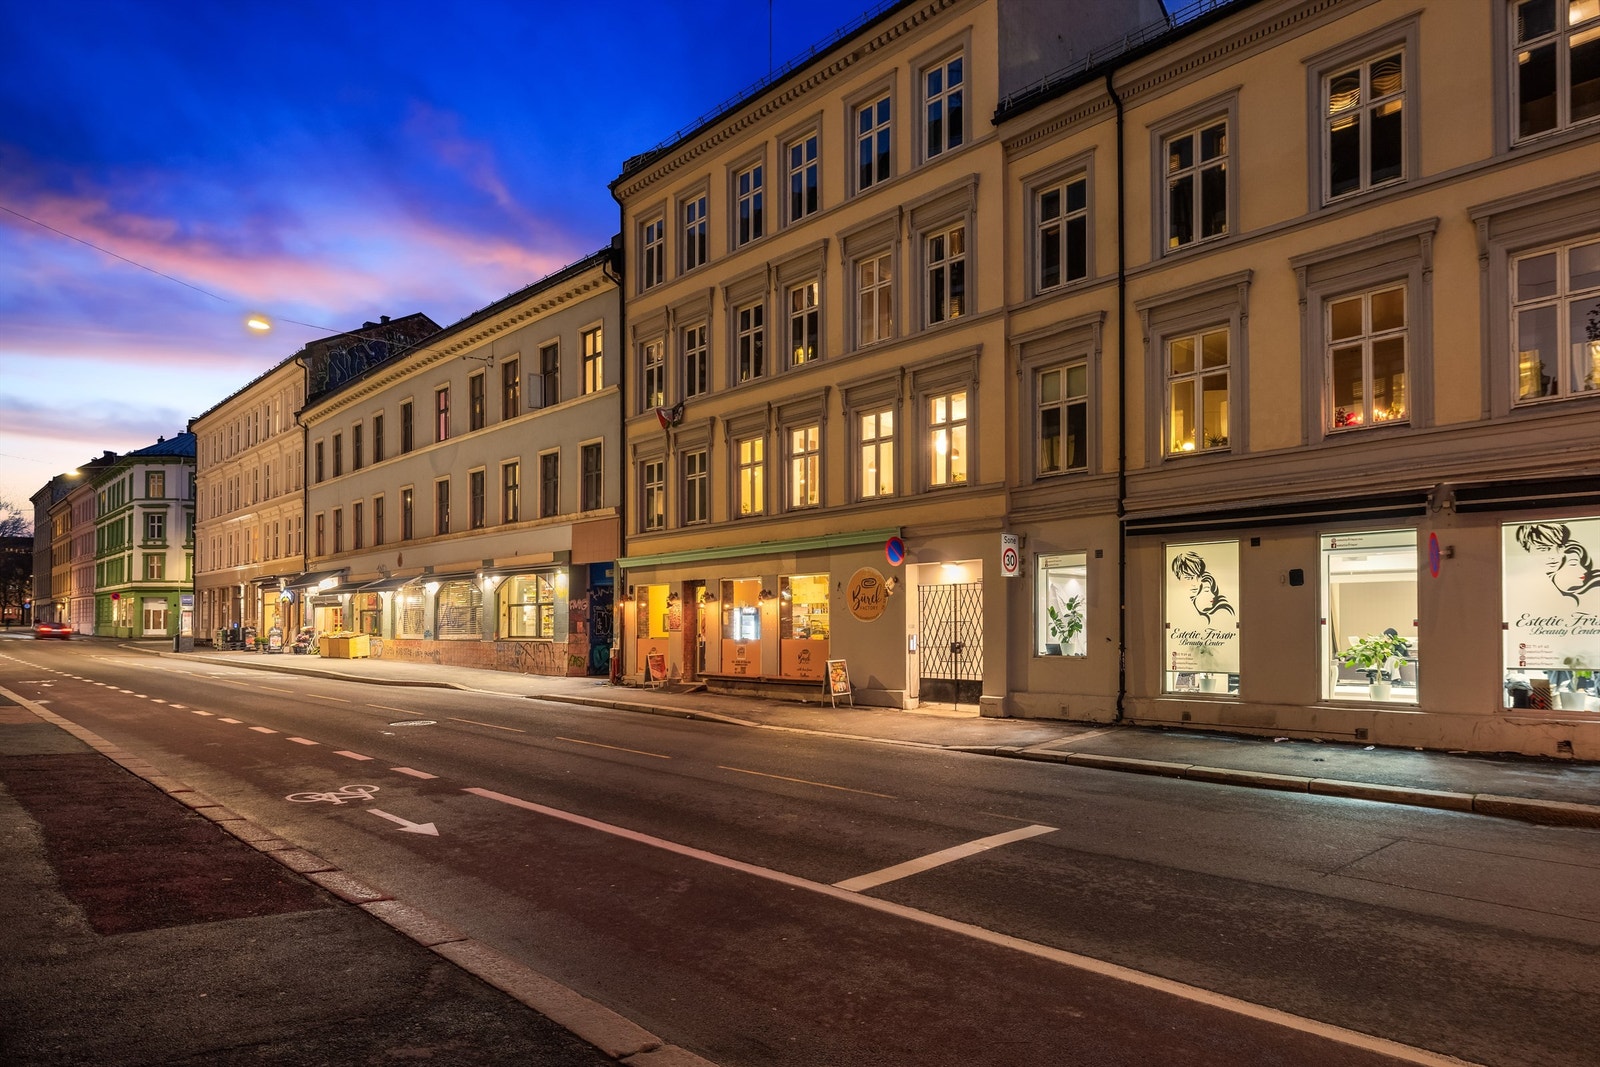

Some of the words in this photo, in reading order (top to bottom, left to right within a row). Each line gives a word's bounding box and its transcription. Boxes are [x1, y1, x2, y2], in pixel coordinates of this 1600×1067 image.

[1004, 536, 1016, 544] Sone
[1006, 555, 1014, 566] 30
[1516, 613, 1564, 627] Estetic
[1171, 628, 1200, 639] Estetic
[1529, 626, 1568, 637] Beauty
